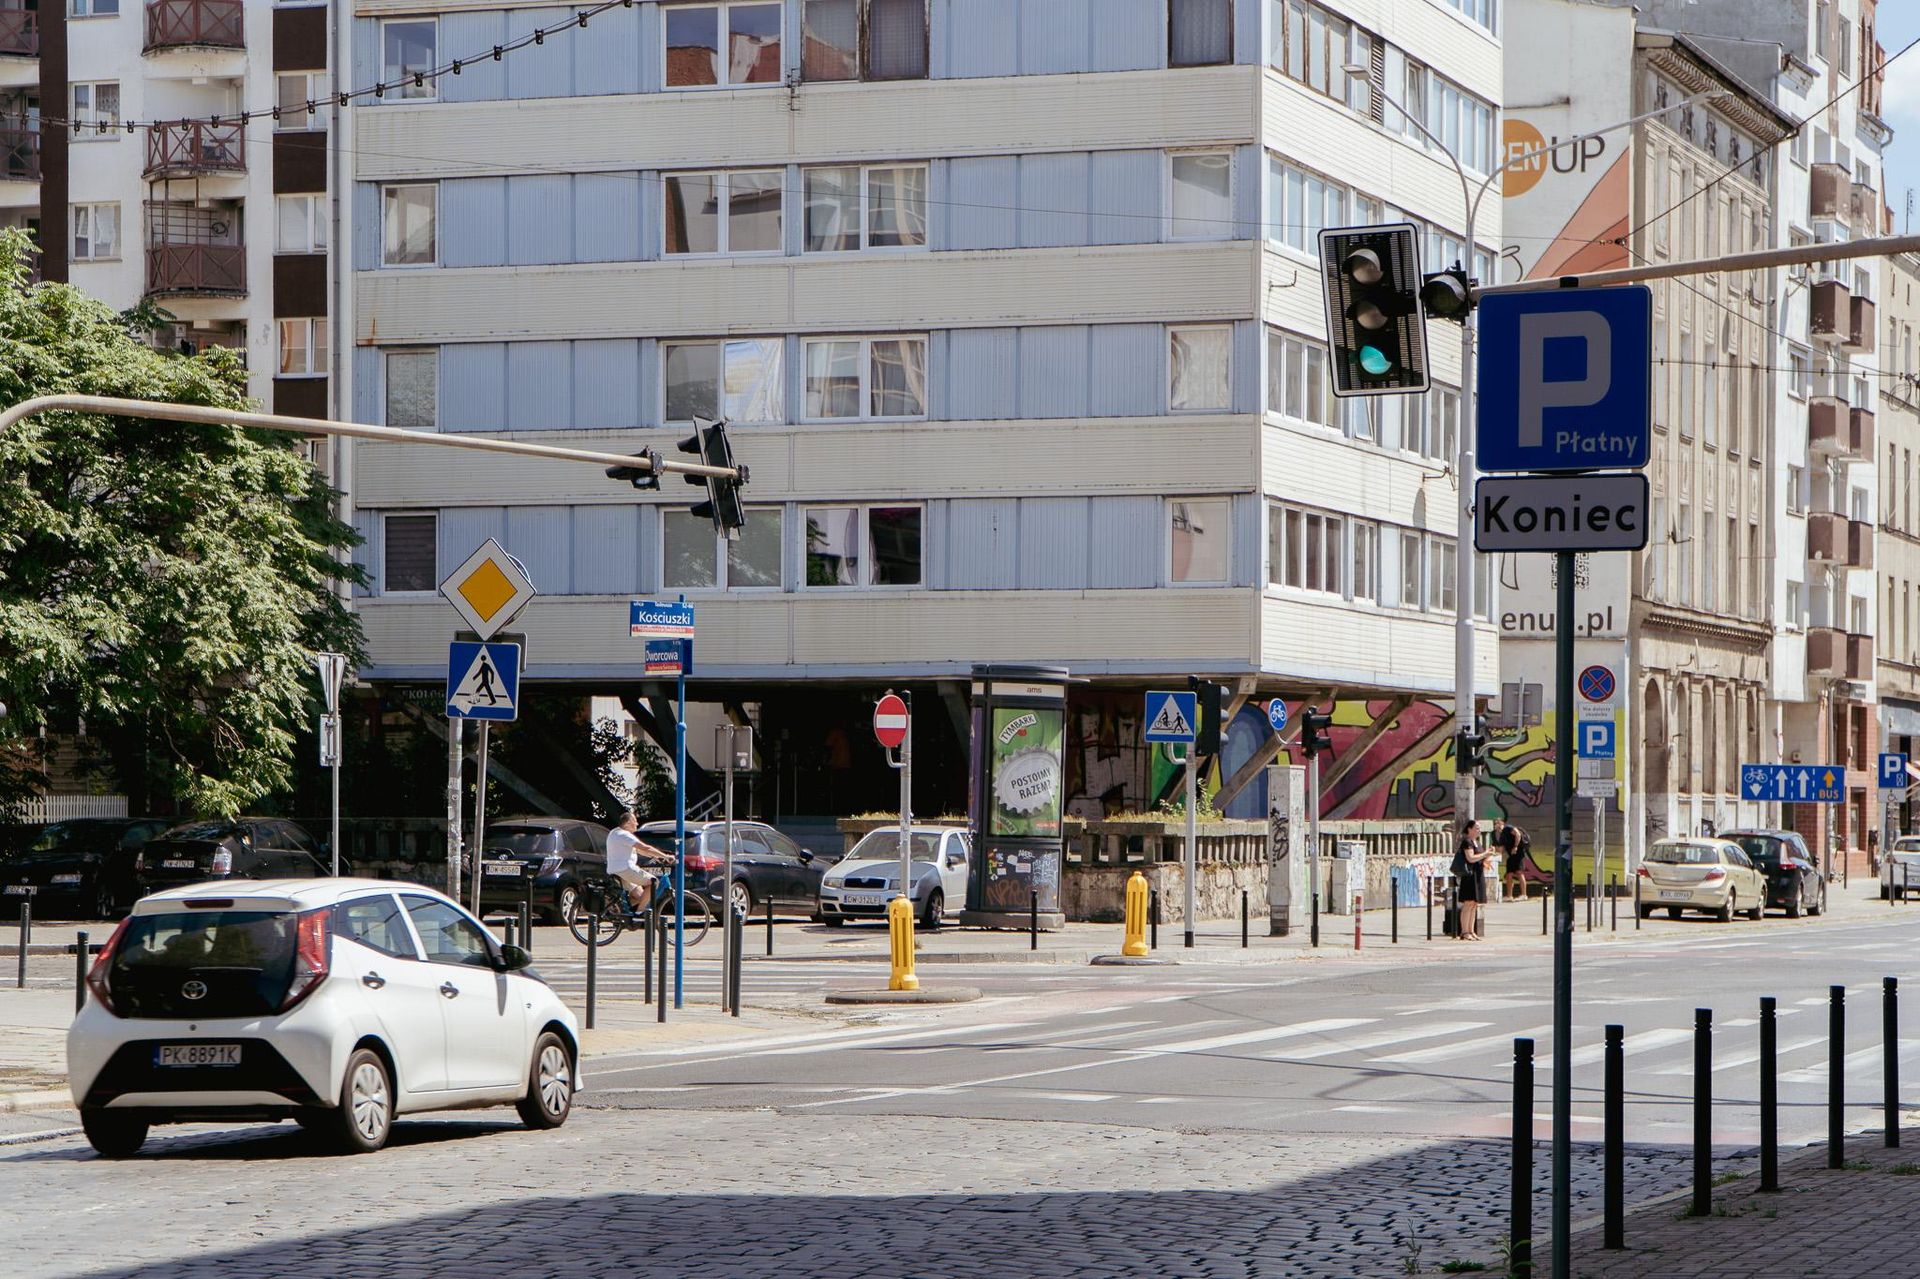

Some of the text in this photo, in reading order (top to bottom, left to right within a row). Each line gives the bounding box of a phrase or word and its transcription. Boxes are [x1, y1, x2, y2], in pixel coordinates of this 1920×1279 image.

[1503, 135, 1606, 173] EN UP
[1518, 310, 1612, 448] P
[1556, 430, 1638, 458] Płatny
[1484, 494, 1636, 534] Koniec
[639, 610, 691, 625] Kościuszki
[1501, 606, 1613, 639] enu.pl
[645, 650, 679, 661] Dworcowa
[1001, 715, 1035, 741] TYMBARK
[1586, 725, 1608, 754] P
[1010, 767, 1052, 789] POSTOIMY
[1884, 755, 1901, 778] P
[1018, 779, 1052, 800] RAZEM?
[1818, 789, 1839, 799] BUS
[162, 1046, 239, 1063] PK 8891K
